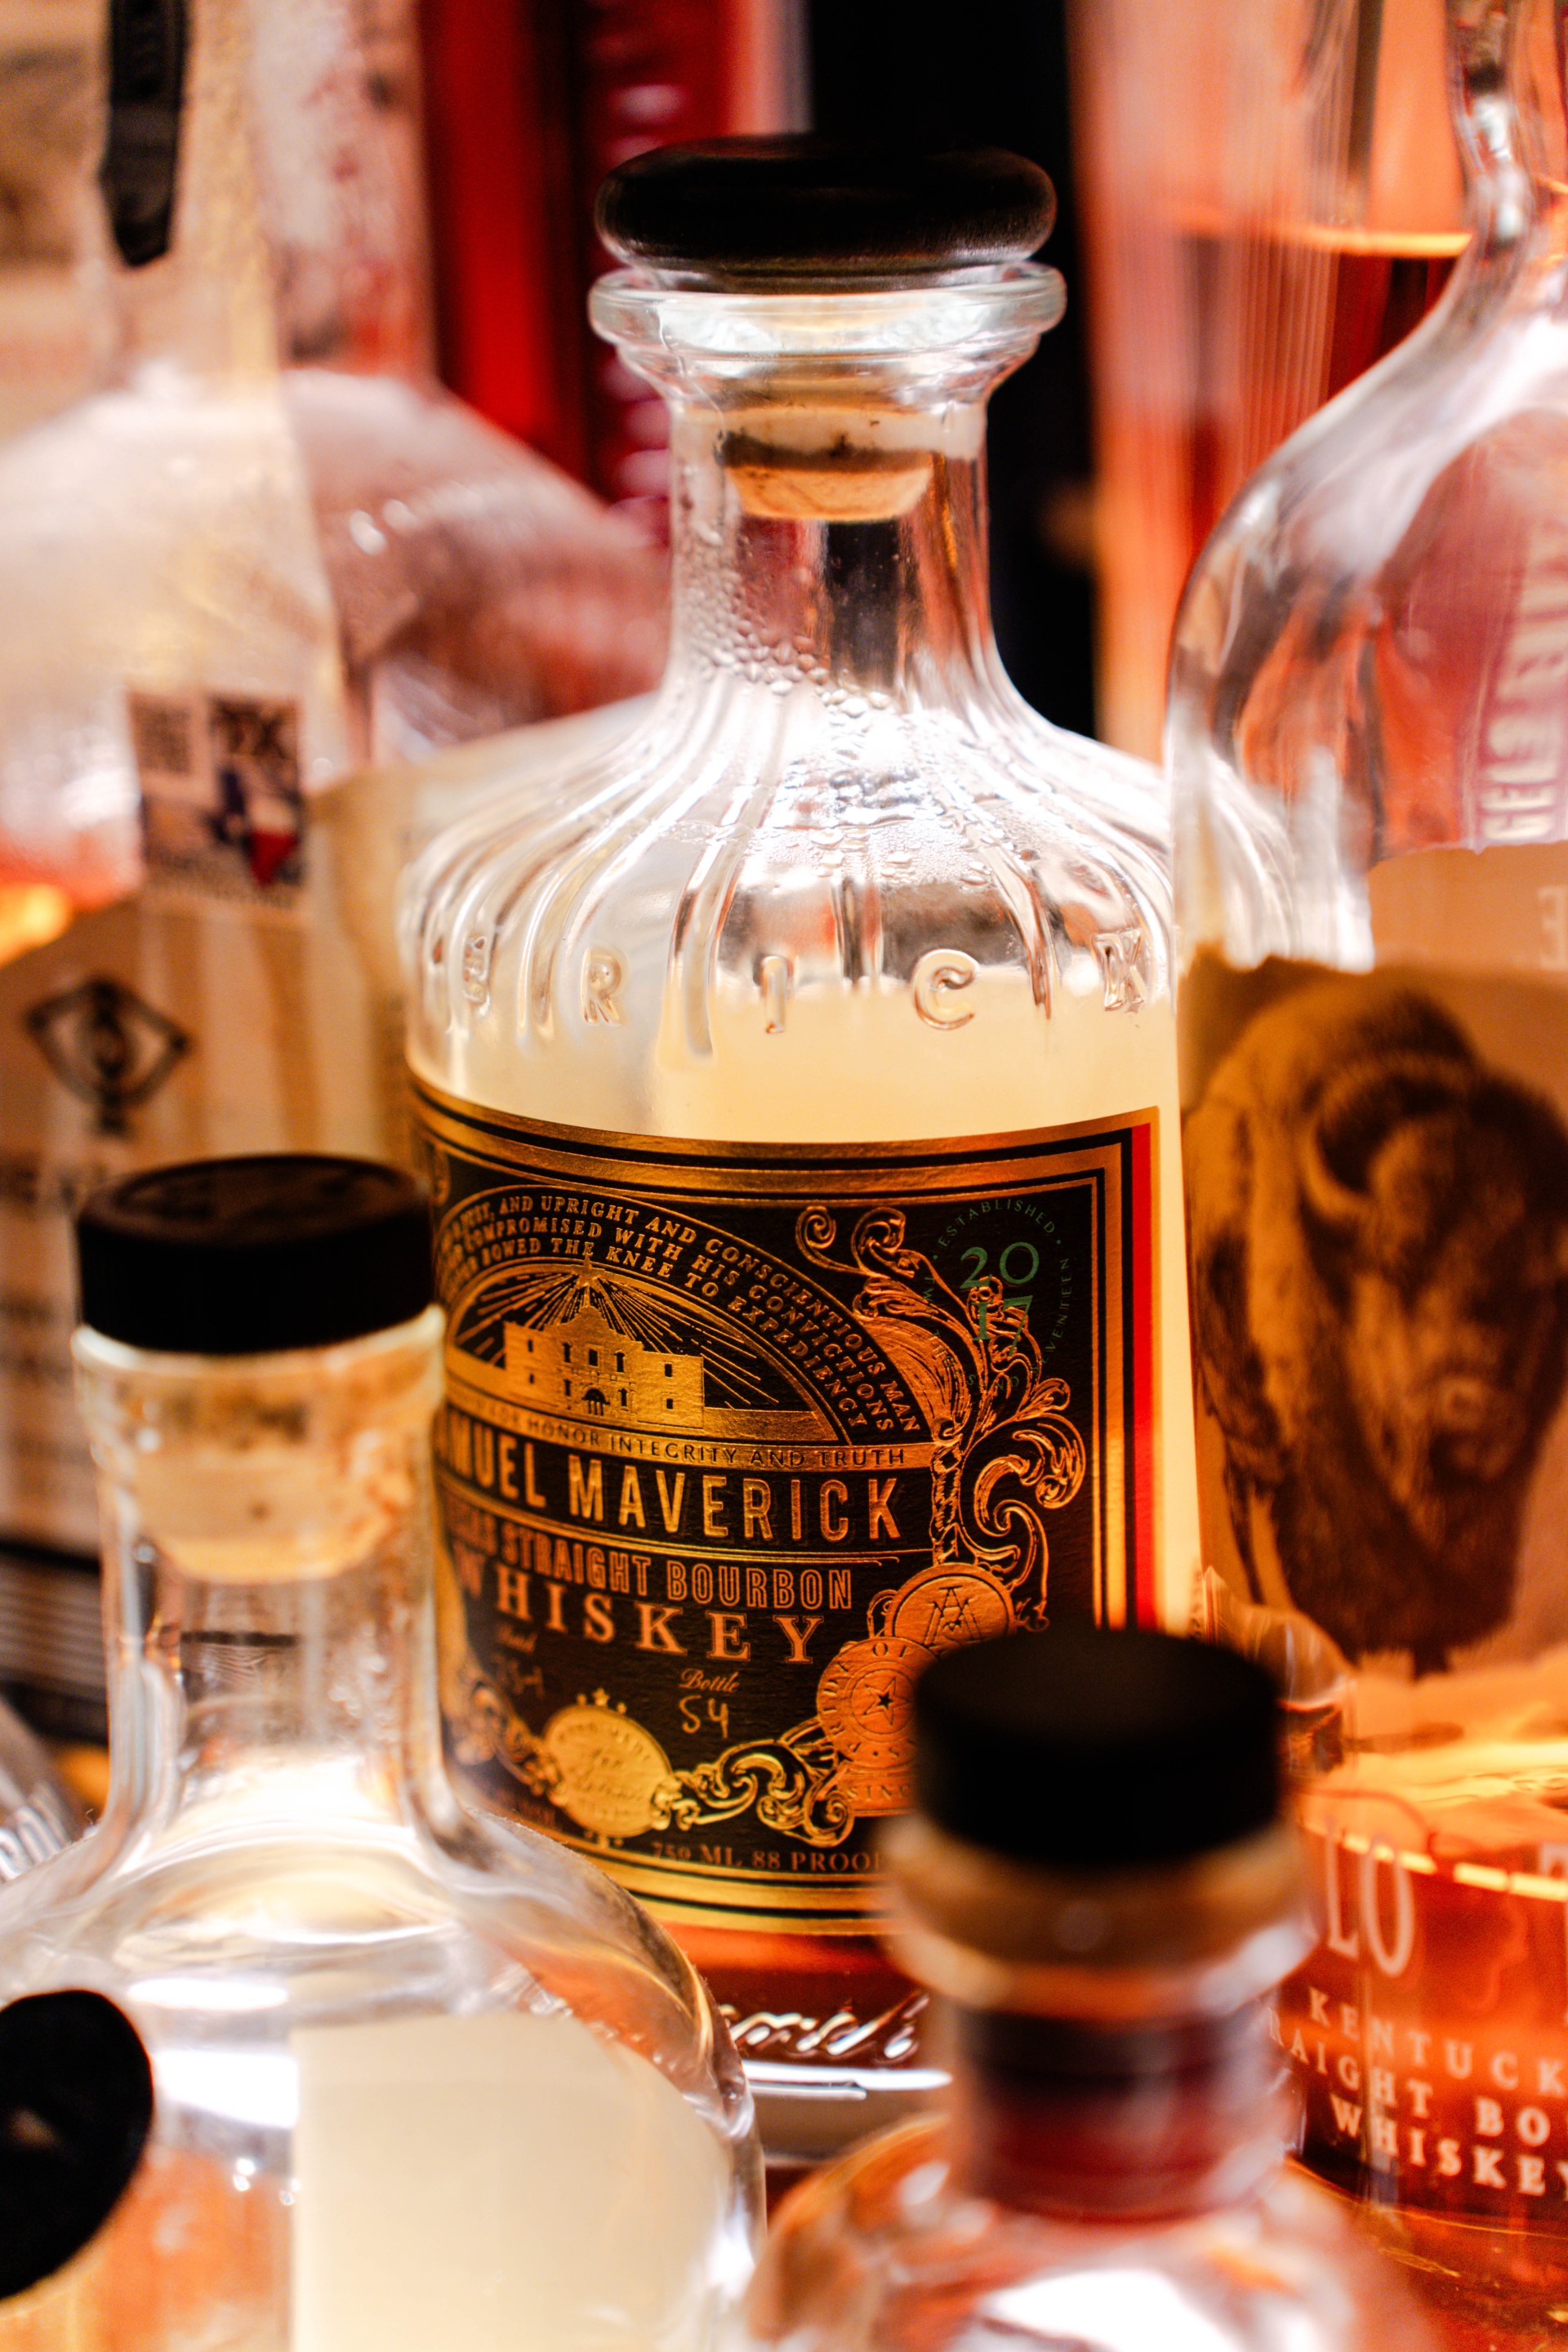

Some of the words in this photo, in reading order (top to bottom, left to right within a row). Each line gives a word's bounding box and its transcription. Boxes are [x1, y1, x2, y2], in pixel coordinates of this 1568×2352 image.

[938, 1199, 1055, 1247] ESTABLISHED
[960, 1241, 1040, 1290] 20
[499, 1196, 533, 1215] AND
[541, 1196, 639, 1224] UPRIGHT
[645, 1217, 697, 1244] AND
[705, 1239, 886, 1375] CONSCIENTIOUS
[880, 1380, 920, 1432] MAN
[551, 1237, 595, 1256] THE
[605, 1245, 674, 1279] KNEE
[684, 1272, 719, 1297] TO
[728, 1296, 867, 1427] EXPEDIENCY
[616, 1227, 683, 1261] WITH
[692, 1254, 740, 1286] HIS
[749, 1285, 894, 1431] CONVICTIONS
[972, 1295, 1033, 1357] 17
[528, 1416, 599, 1447] HONOR
[610, 1436, 737, 1464] INTEGRITY
[750, 1450, 805, 1468] AND
[819, 1449, 905, 1468] TRUTH
[568, 1454, 901, 1544] MAVERICK
[453, 1541, 824, 1664] WHISKEY
[501, 1521, 652, 1597] STRAIGHT
[666, 1560, 852, 1610] BOURBON
[679, 1668, 741, 1693] Bottle
[847, 1784, 911, 1801] SINC
[650, 1842, 691, 1862] 750
[752, 1851, 781, 1870] 88
[1325, 1815, 1417, 1978] LO
[1267, 2007, 1433, 2118] RAIGHT
[1475, 2095, 1568, 2149] BO
[1309, 1986, 1568, 2098] KENTUCK
